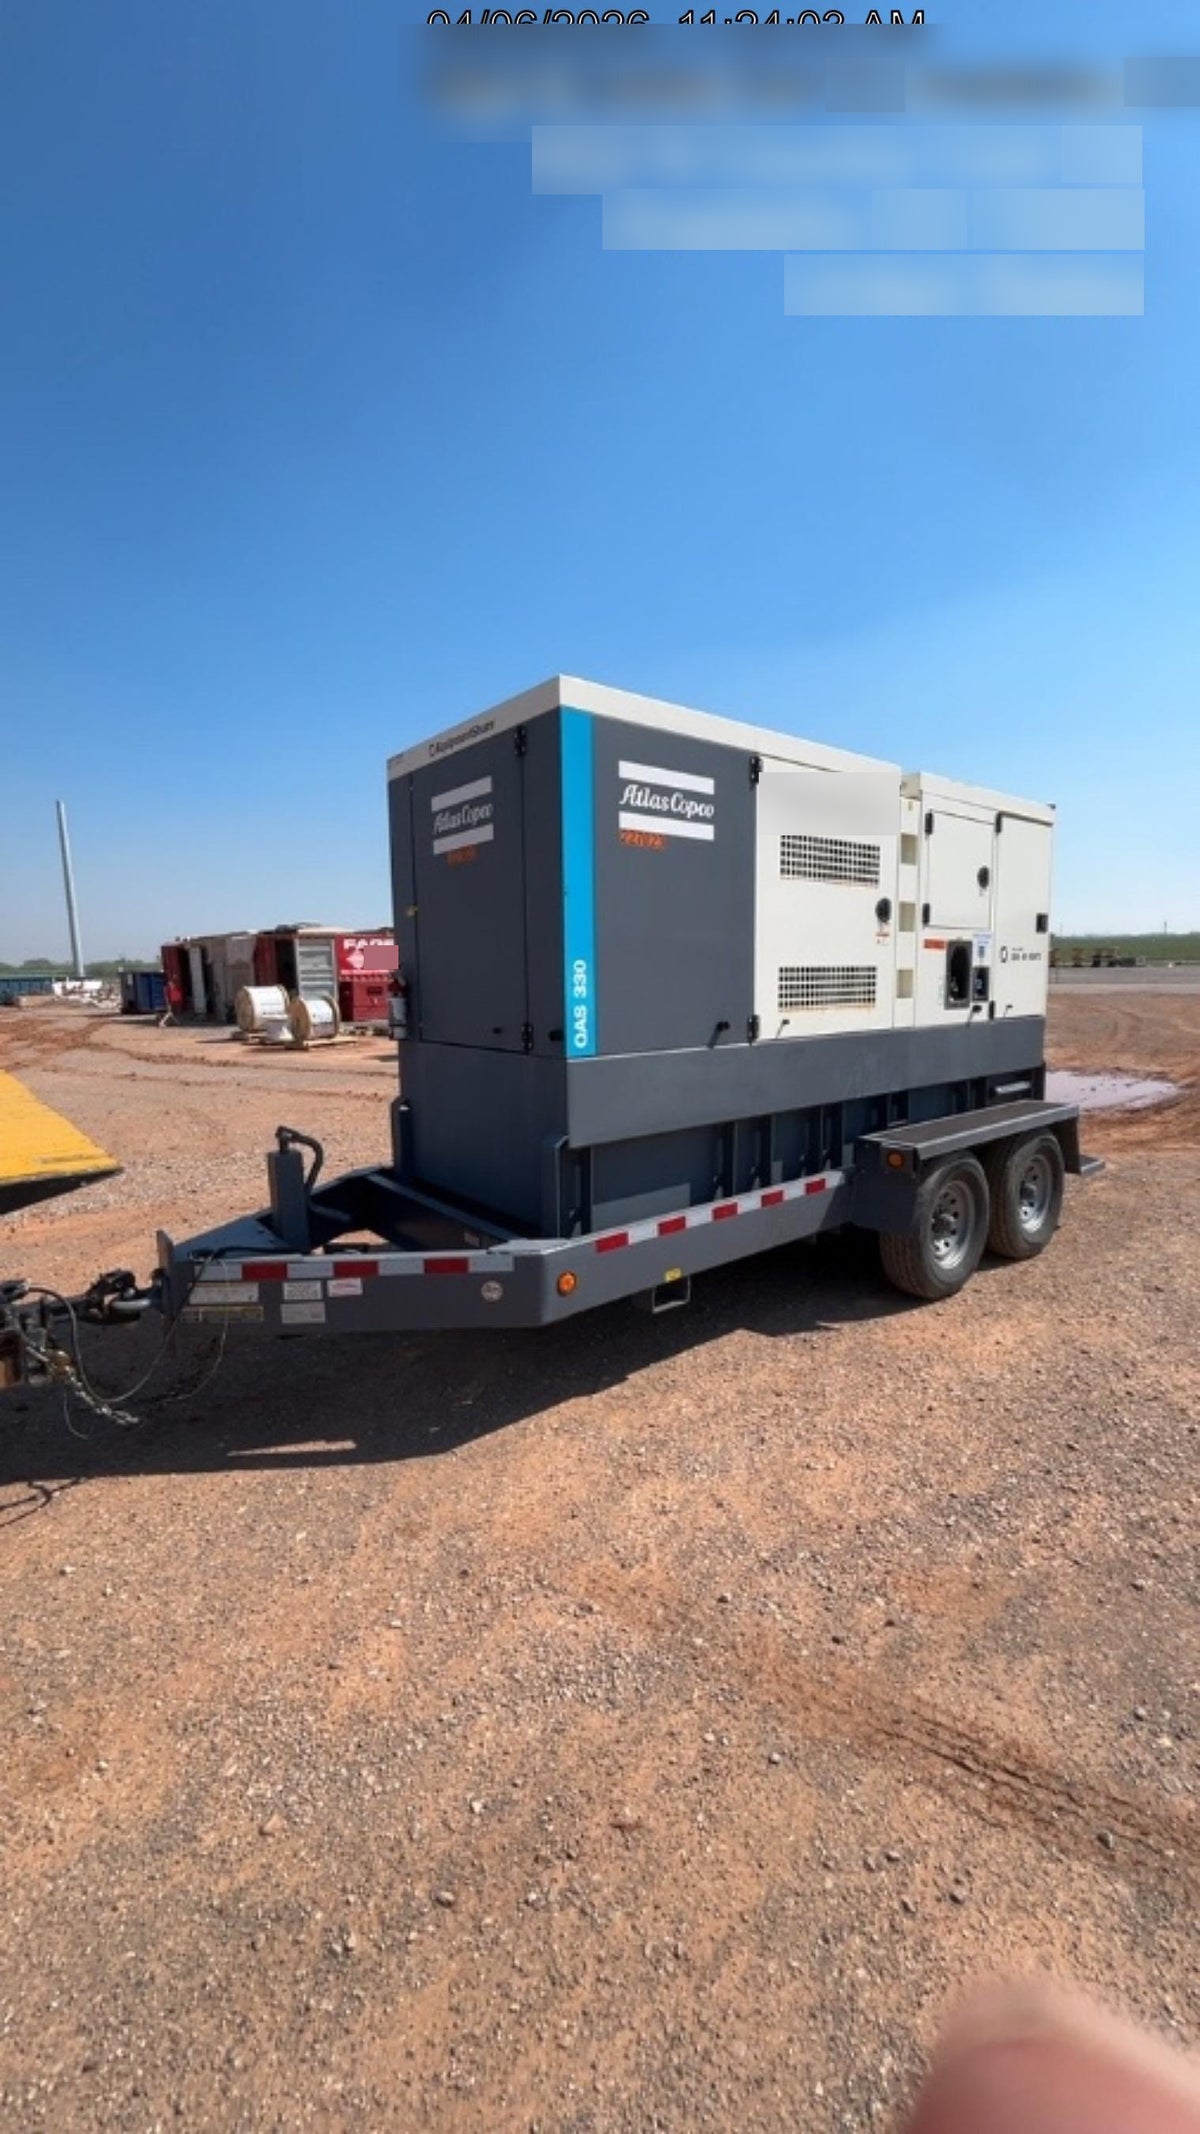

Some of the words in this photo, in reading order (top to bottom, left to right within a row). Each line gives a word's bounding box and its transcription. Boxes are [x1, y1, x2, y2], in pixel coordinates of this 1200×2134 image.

[432, 811, 461, 835] Atlas
[461, 803, 493, 825] Copco
[619, 783, 670, 811] Atlas
[670, 792, 714, 818] Copco
[573, 959, 587, 999] 330
[574, 1004, 588, 1049] QAS
